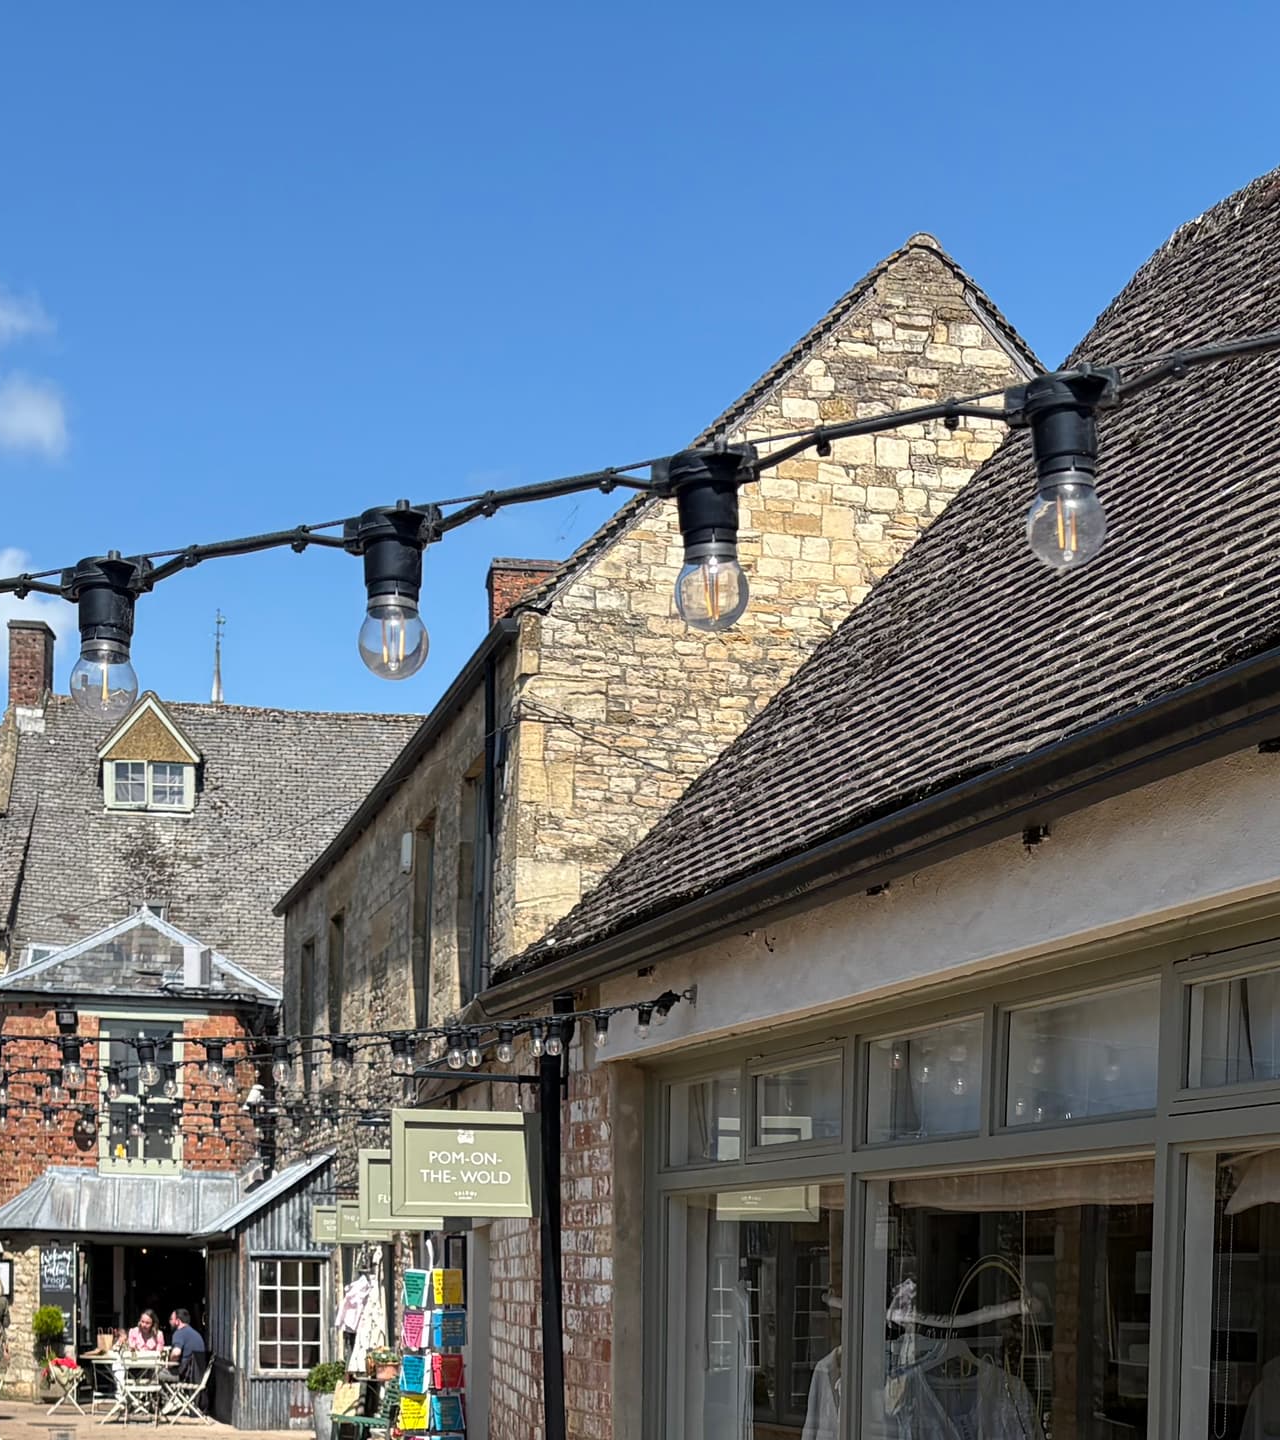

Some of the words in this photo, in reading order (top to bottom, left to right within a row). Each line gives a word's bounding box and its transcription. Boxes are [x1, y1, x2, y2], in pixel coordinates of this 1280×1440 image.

[429, 1151, 503, 1165] POM-ON-
[421, 1169, 456, 1183] THE-
[460, 1170, 511, 1184] WOLD
